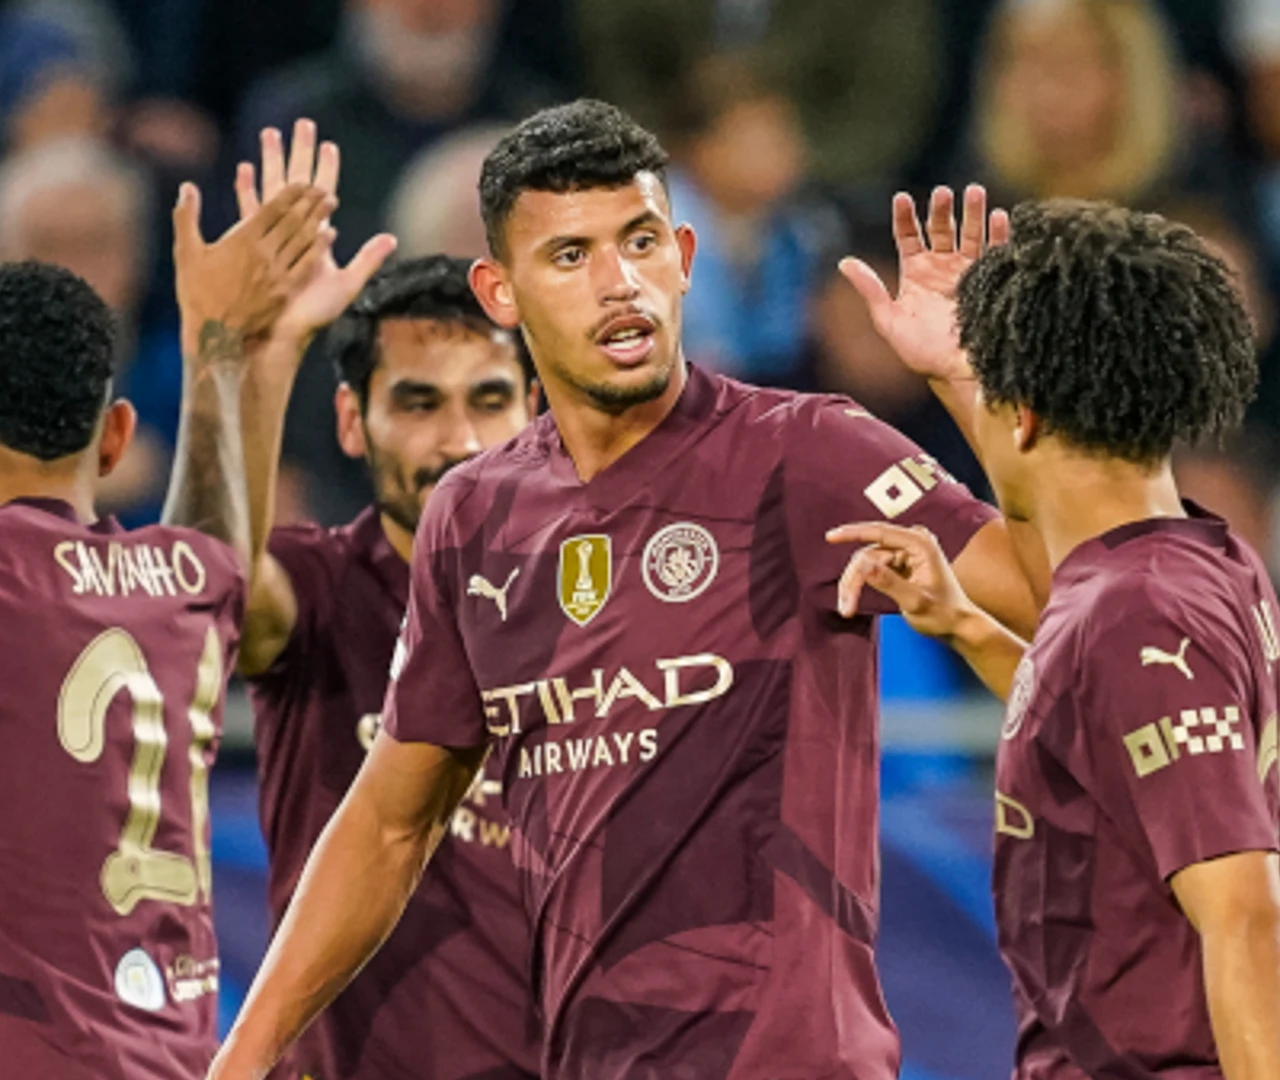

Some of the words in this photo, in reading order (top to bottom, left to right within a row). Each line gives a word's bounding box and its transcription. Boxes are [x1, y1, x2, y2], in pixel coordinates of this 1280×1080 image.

[54, 540, 206, 597] SAVINHO
[480, 652, 734, 737] ETIHAD
[519, 728, 658, 778] AIRWAYS
